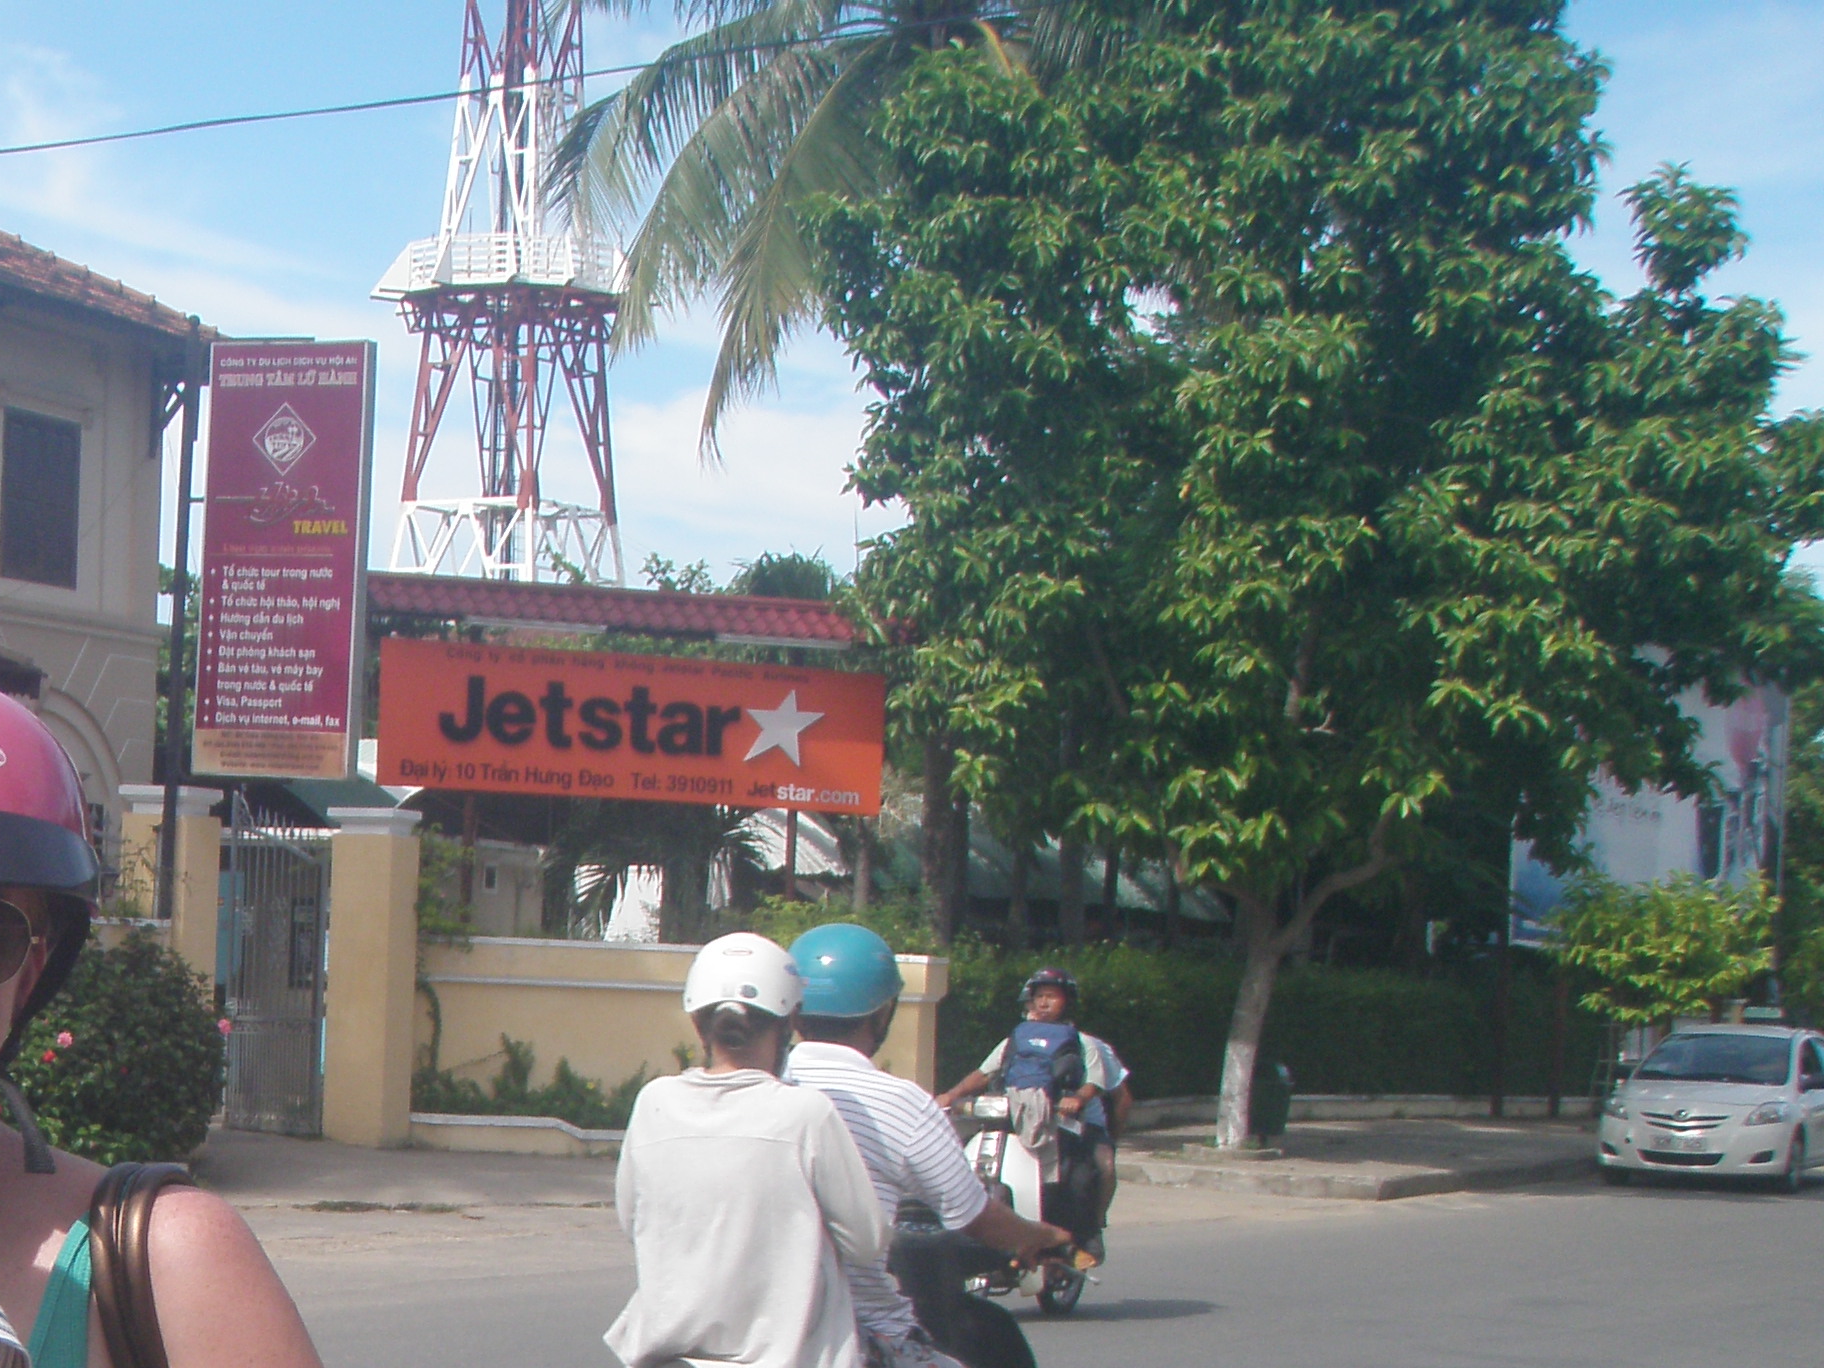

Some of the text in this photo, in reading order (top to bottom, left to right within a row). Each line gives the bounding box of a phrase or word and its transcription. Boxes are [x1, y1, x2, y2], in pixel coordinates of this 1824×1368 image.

[247, 358, 257, 366] TY
[293, 519, 348, 535] TRAVEL
[261, 567, 280, 577] tour
[282, 567, 307, 580] trong
[272, 613, 285, 624] du
[286, 613, 304, 626] lịch
[268, 646, 296, 658] khách
[298, 648, 316, 660] sạn
[284, 664, 304, 677] máy
[306, 664, 323, 678] bay
[217, 680, 242, 692] trong
[269, 680, 276, 691] &
[241, 695, 282, 709] Passport
[325, 715, 340, 727] fax
[438, 675, 742, 756] Jetstar
[400, 758, 427, 779] Đại
[457, 763, 475, 780] 10
[480, 760, 519, 782] Trần
[526, 766, 572, 790] Hưng
[579, 769, 614, 790] Đạo
[631, 772, 661, 790] Tel:
[667, 775, 733, 794] 3910911
[747, 781, 860, 805] Jetstar.com
